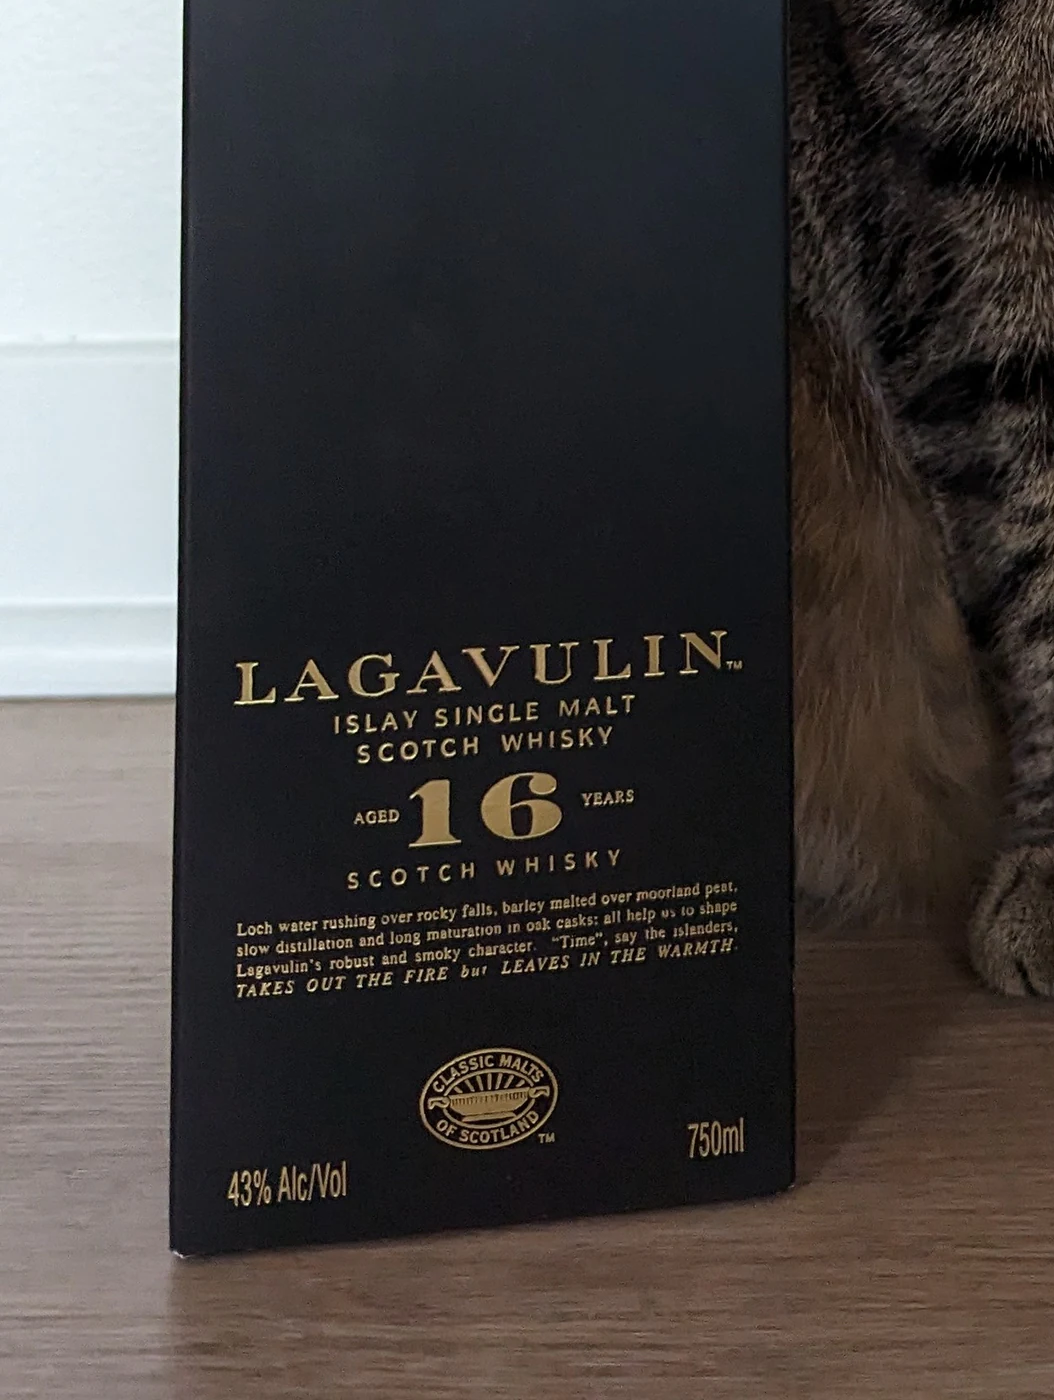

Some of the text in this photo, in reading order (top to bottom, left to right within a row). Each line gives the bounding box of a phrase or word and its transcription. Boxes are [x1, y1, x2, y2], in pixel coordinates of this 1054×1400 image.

[234, 630, 727, 705] LAGAVULIN
[335, 694, 635, 734] ISLAY SINGLE MALT
[357, 726, 613, 764] SCOTCH WHISKY
[353, 772, 635, 848] AGED 16 YEARS
[347, 849, 621, 890] SCOTCH WHISKY
[237, 922, 273, 937] Loch
[278, 920, 318, 932] water
[322, 914, 376, 929] rushing
[381, 913, 413, 925] over
[416, 906, 457, 922] rocky
[462, 902, 498, 918] falls,
[502, 899, 545, 914] barley
[550, 893, 596, 909] malted
[601, 892, 632, 904] over
[636, 883, 700, 902] moorland
[237, 943, 270, 957] slow
[276, 937, 353, 954] distillation
[359, 932, 385, 947] and
[390, 931, 421, 946] long
[427, 924, 501, 941] maturation
[508, 923, 521, 934] in
[526, 918, 550, 932] oak
[604, 910, 621, 925] all
[627, 907, 656, 923] help
[661, 909, 676, 919] us
[681, 906, 695, 916] to
[700, 901, 737, 916] shape
[236, 959, 321, 979] Lagavulin's
[330, 955, 374, 970] robust
[382, 951, 407, 965] and
[415, 946, 460, 966] smoky
[615, 931, 637, 945] say
[645, 927, 666, 939] the
[236, 980, 295, 998] TAKES
[306, 976, 346, 993] OUT
[356, 971, 393, 989] THE
[404, 966, 449, 984] FIRE
[460, 964, 488, 978] but
[501, 955, 570, 975] LEAVES
[580, 952, 601, 967] IN
[610, 946, 647, 964] THE
[432, 1053, 545, 1093] CLASSIC MALTS
[436, 1110, 540, 1144] OF SCOTLAND
[687, 1117, 744, 1158] 750ml
[227, 1160, 347, 1207] 43% Alc/Vol
